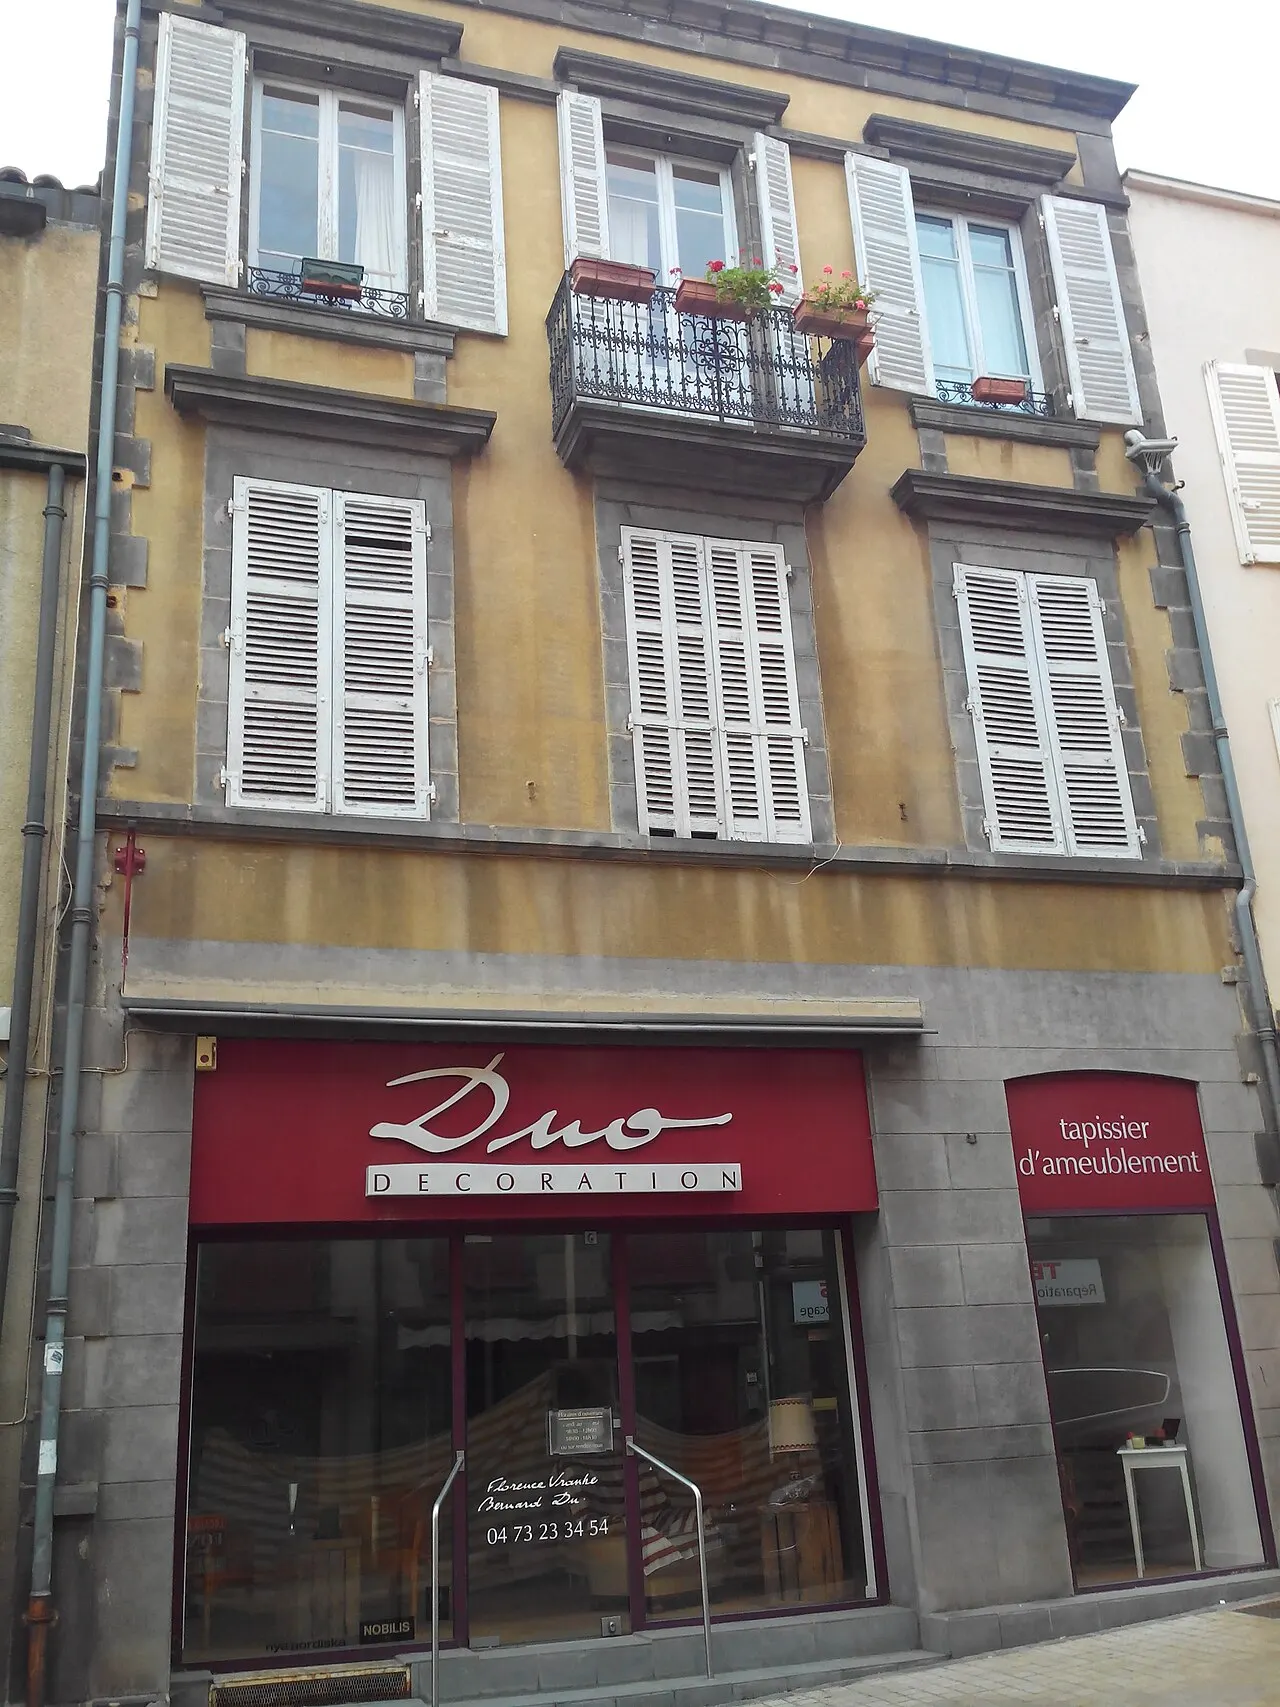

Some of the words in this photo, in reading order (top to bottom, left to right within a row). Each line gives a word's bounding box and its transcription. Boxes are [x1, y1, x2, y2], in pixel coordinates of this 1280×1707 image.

[368, 1052, 733, 1154] Duo
[1059, 1115, 1149, 1148] tapissier
[1019, 1147, 1202, 1176] d'ameublement
[373, 1170, 738, 1193] DECORATION
[487, 1477, 546, 1492] Florence
[477, 1496, 542, 1512] Bernard
[487, 1526, 507, 1545] 04
[513, 1524, 533, 1542] 73
[539, 1522, 558, 1540] 23
[564, 1520, 584, 1538] 34
[589, 1518, 609, 1536] 54
[363, 1621, 410, 1636] NOBILIS
